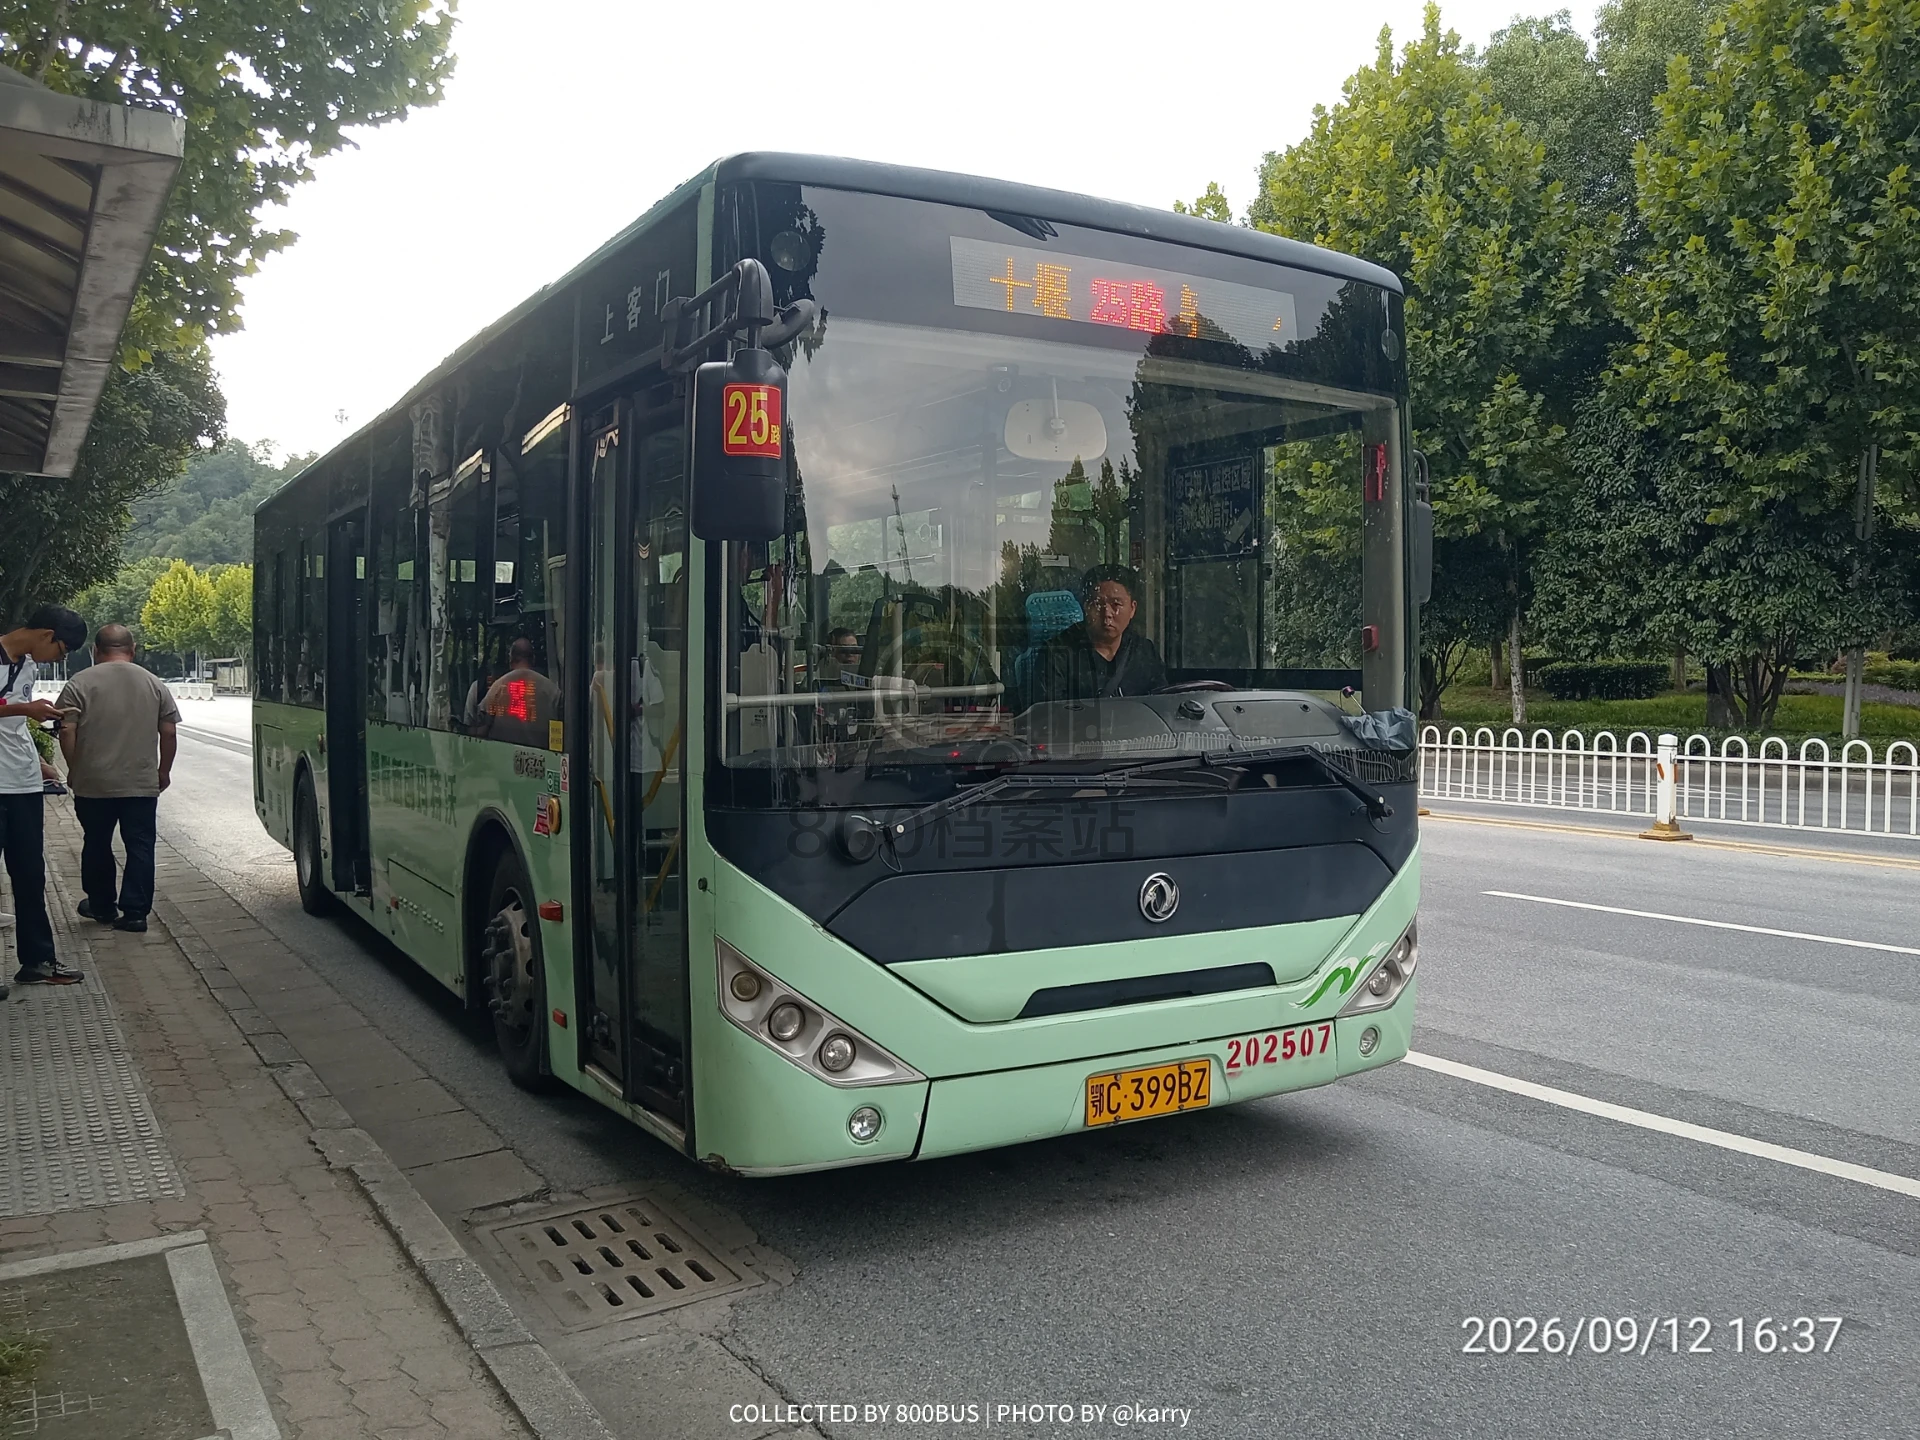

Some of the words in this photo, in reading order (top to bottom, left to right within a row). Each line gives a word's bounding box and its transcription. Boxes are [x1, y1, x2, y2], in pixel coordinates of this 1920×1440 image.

[600, 269, 670, 345] 上客门
[989, 257, 1072, 320] 十堰
[1091, 280, 1166, 333] 25路
[1226, 1025, 1331, 1069] 202507
